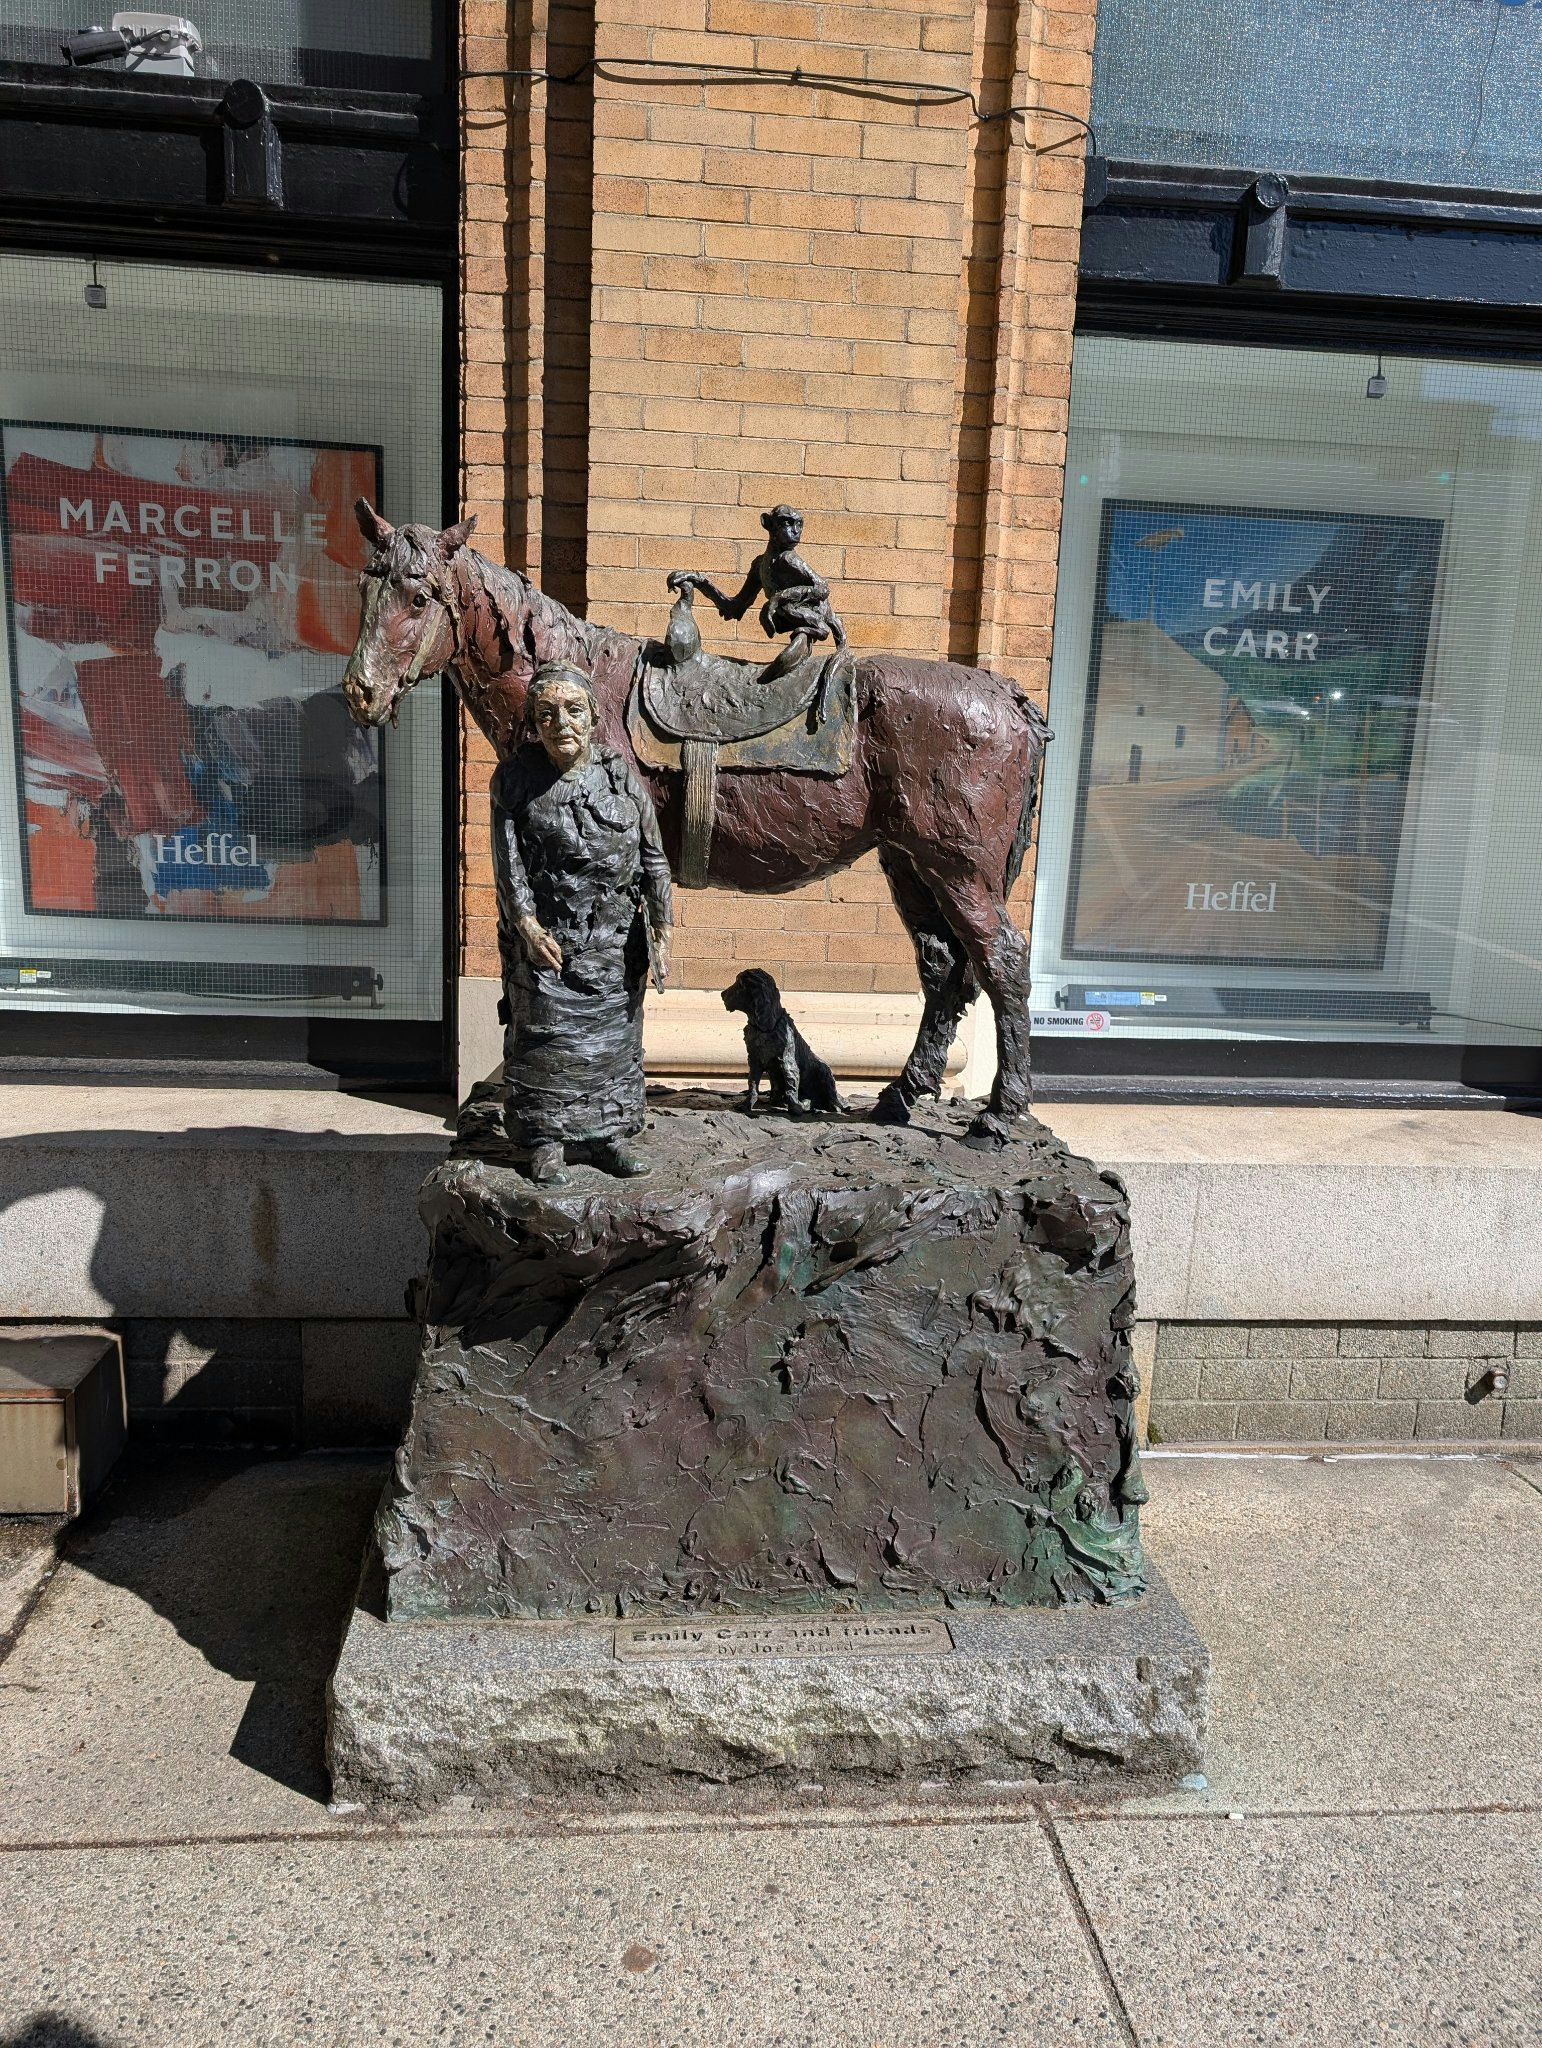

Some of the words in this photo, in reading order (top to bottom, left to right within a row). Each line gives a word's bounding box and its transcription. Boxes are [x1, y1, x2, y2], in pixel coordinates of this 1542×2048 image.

[59, 497, 328, 546] MARCELLE
[95, 551, 299, 594] FERRON
[1203, 578, 1331, 614] EMILY
[1203, 626, 1319, 660] CARR
[152, 832, 260, 867] Heffel
[1184, 881, 1277, 912] Heffel
[1033, 1017, 1045, 1025] NO
[1047, 1017, 1084, 1026] SMOKING
[632, 1629, 702, 1642] Emily
[717, 1628, 772, 1639] Carr
[785, 1626, 830, 1637] and
[844, 1624, 931, 1636] friends
[718, 1644, 737, 1656] by
[751, 1642, 784, 1653] Joe
